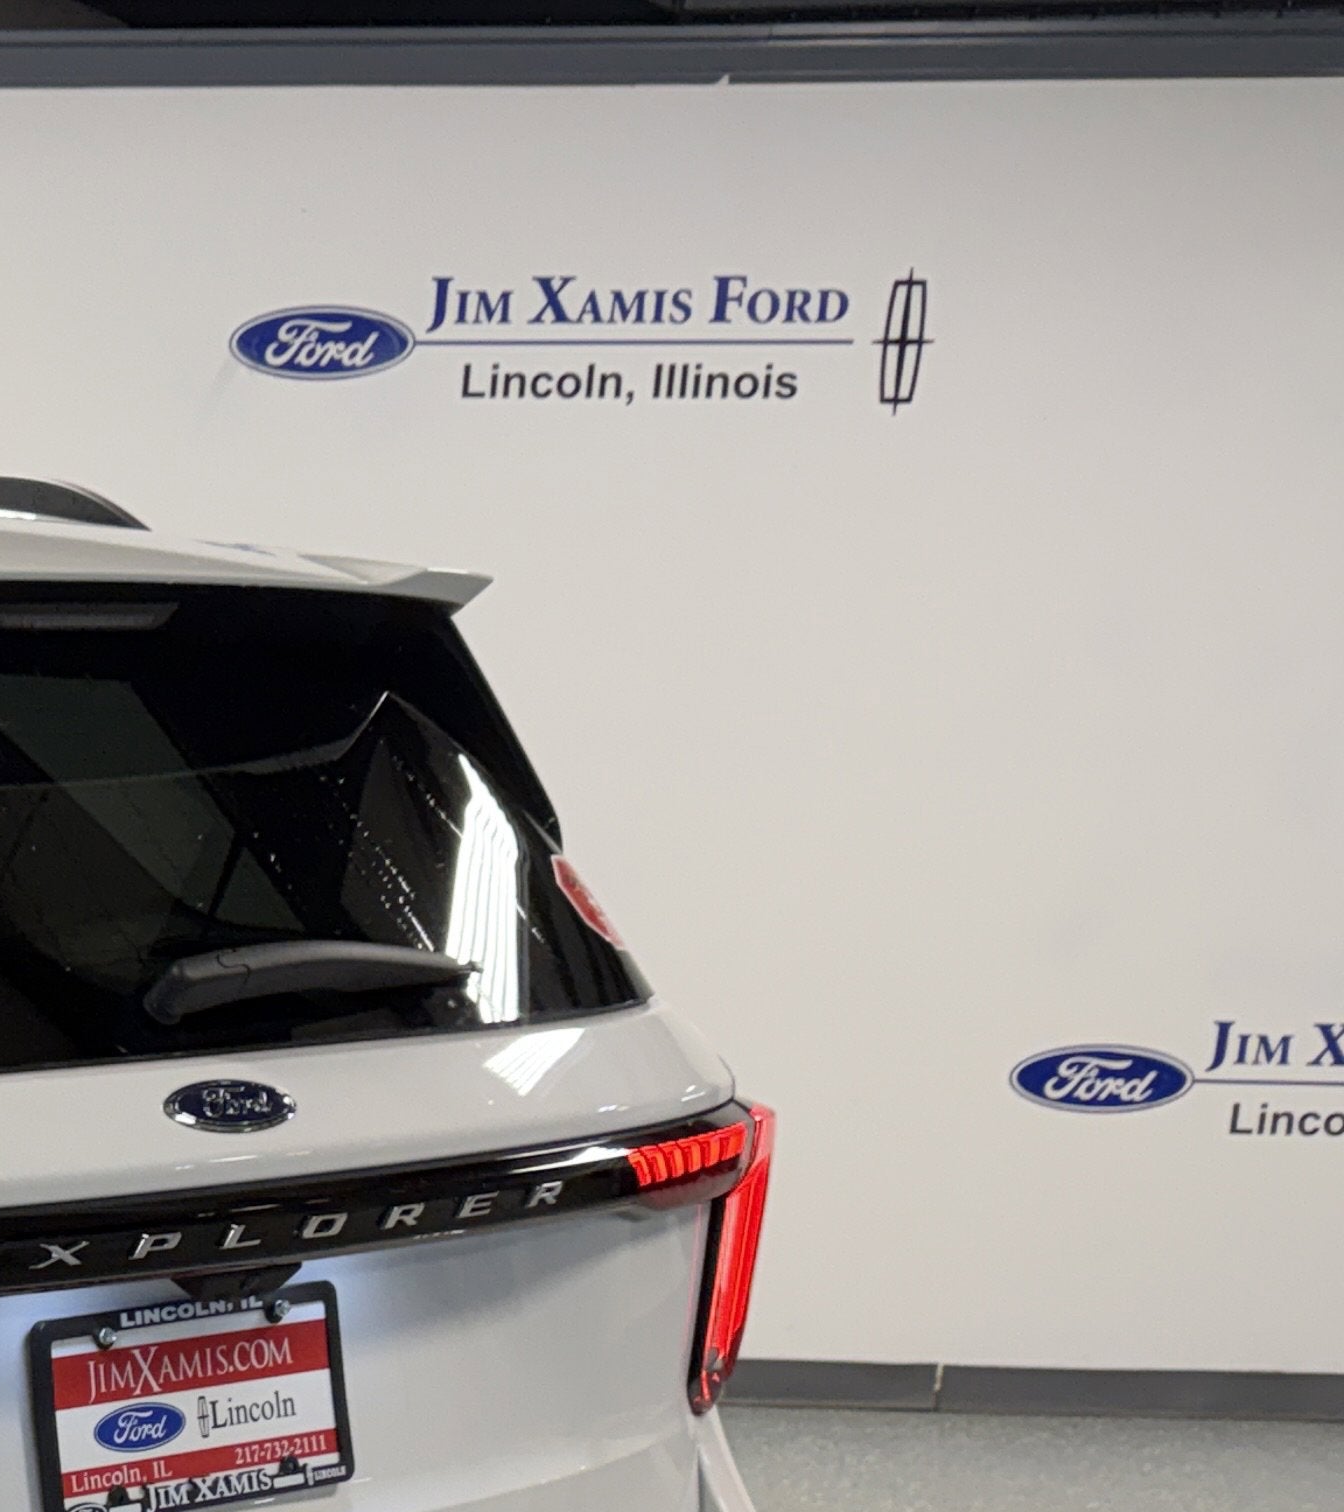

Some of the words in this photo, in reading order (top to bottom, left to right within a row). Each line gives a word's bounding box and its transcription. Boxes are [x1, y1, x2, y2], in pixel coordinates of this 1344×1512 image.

[426, 276, 513, 333] JIM
[528, 276, 693, 324] XAMIS
[709, 275, 849, 324] FORD
[265, 318, 376, 368] Ford
[461, 363, 635, 405] Lincoln,
[652, 363, 798, 399] Illinois
[1205, 1020, 1294, 1072] JIM
[1043, 1056, 1158, 1103] Ford
[202, 1085, 273, 1118] Ford
[1229, 1102, 1344, 1136] Linco
[119, 1300, 234, 1328] LINCOLN,
[241, 1295, 263, 1310] IL
[113, 1408, 166, 1443] Ford
[211, 1390, 297, 1428] Lincoln
[234, 1434, 328, 1465] 217-732-2111
[71, 1466, 147, 1493] Lincoln,
[153, 1460, 173, 1478] IL
[196, 1469, 272, 1502] XAMIS
